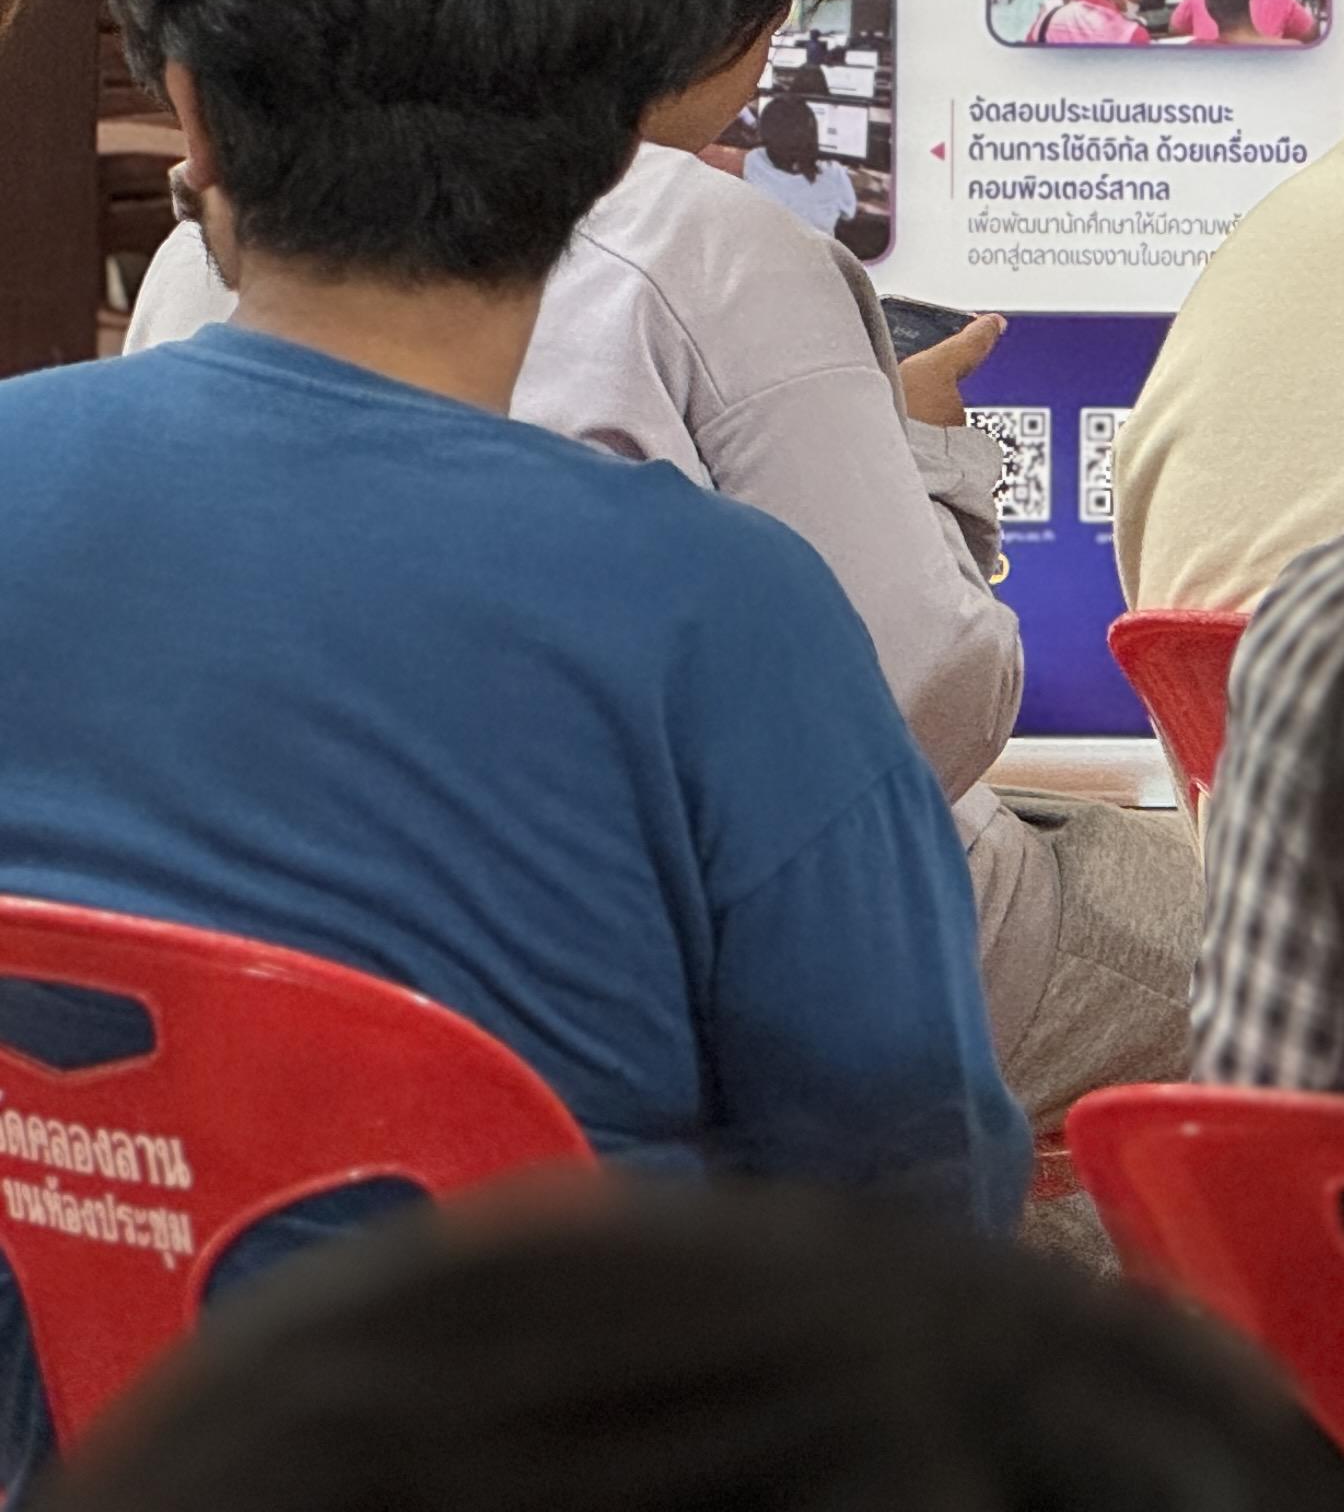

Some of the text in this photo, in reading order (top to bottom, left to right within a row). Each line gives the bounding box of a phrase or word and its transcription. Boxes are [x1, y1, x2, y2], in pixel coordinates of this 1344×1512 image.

[968, 95, 1235, 125] จัดสอบประเมินสมรรถนะ
[968, 129, 1309, 164] ด้านการใช้ดิจิทัล ด้วยเครื่องมือ
[968, 172, 1171, 202] คอมพิวเตอร์สากล
